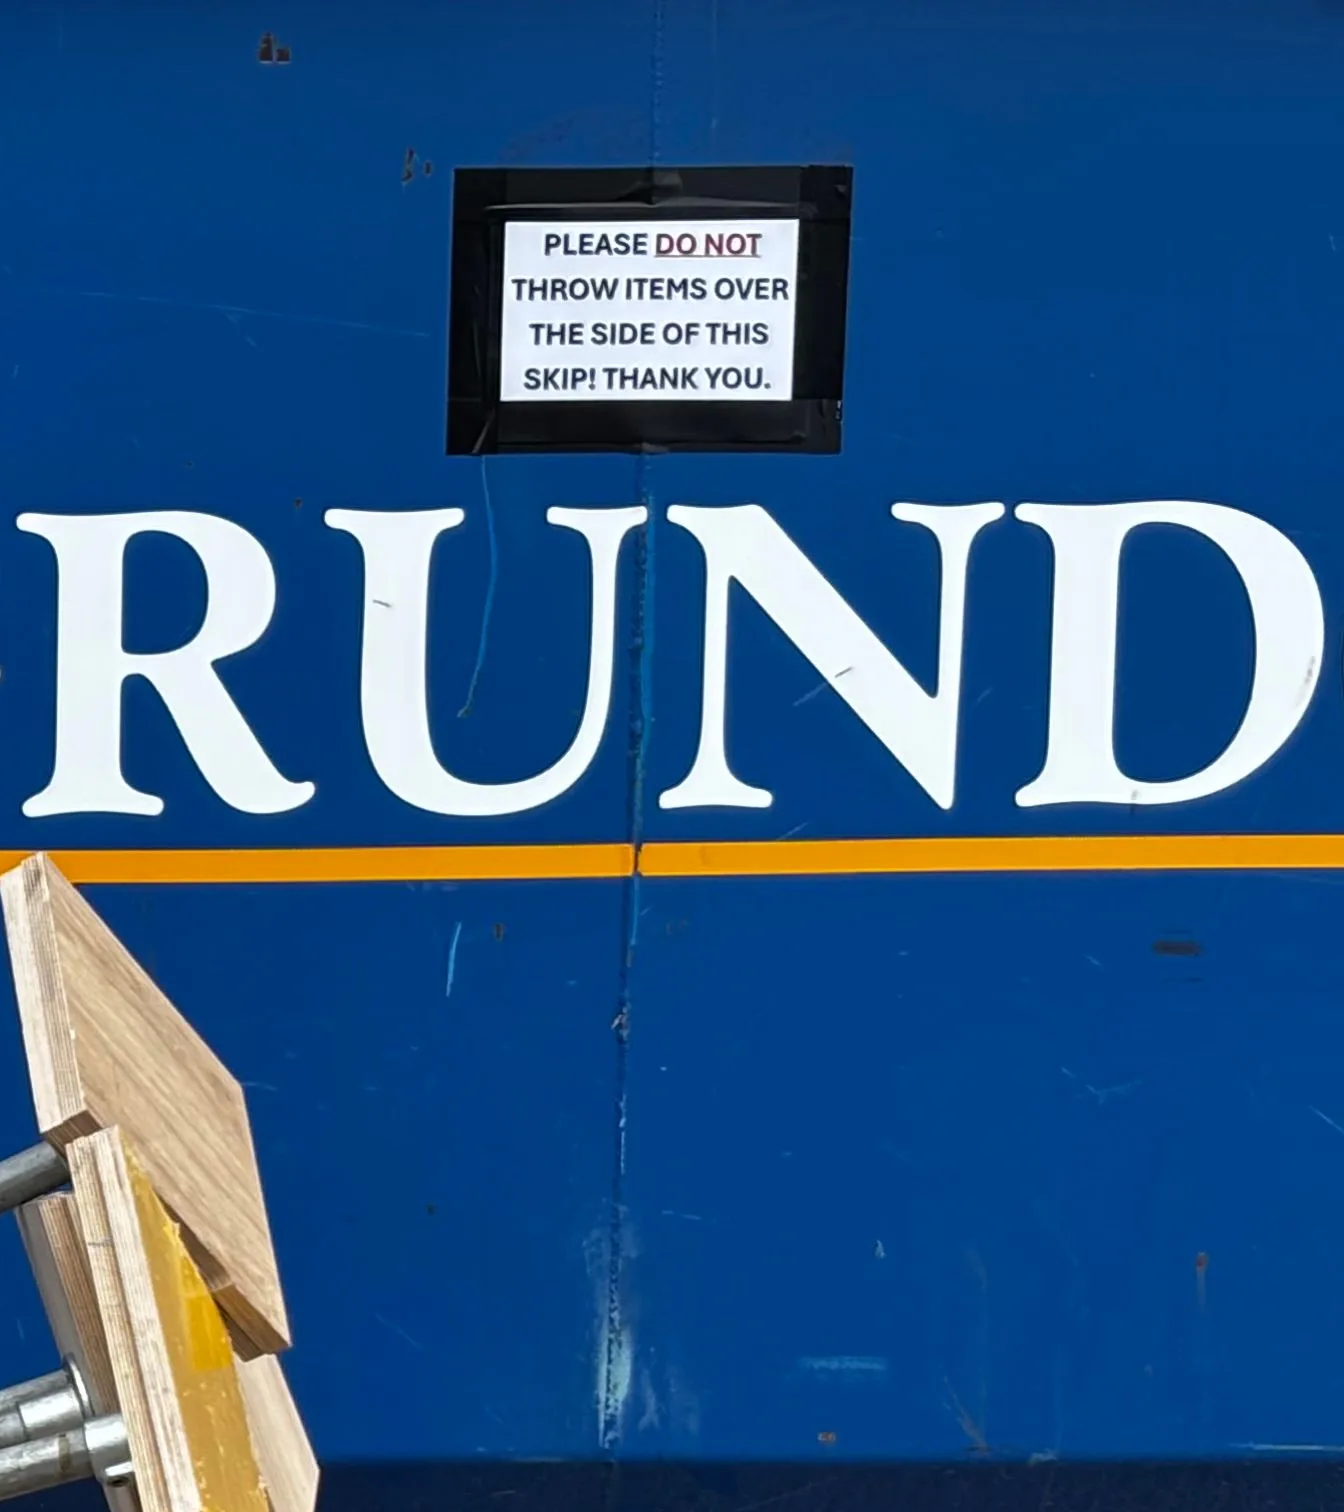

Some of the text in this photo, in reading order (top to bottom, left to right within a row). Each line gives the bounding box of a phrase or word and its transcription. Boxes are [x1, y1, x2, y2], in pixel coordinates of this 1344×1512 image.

[545, 234, 762, 255] PLEASE DO NOT
[512, 278, 788, 300] THROW ITEMS OVER
[529, 323, 768, 345] THE SIDE OF THIS
[524, 368, 770, 390] SKIP! THANK YOU.
